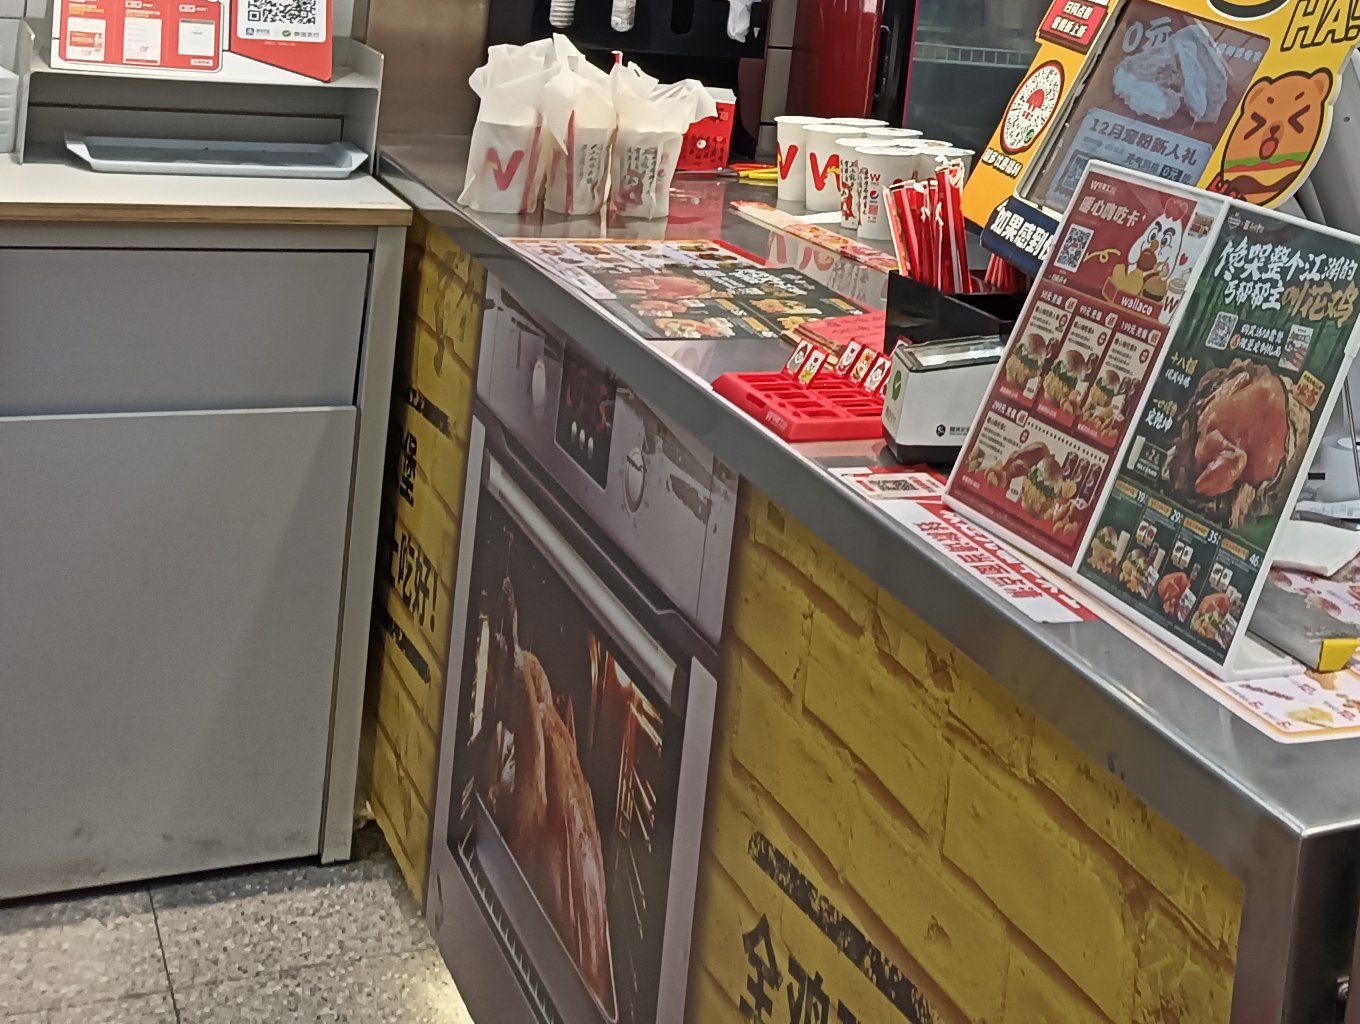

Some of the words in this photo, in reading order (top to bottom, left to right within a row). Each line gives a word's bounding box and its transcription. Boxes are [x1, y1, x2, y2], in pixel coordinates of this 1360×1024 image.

[1213, 235, 1359, 282] 馋哭整个江湖的
[1120, 295, 1154, 316] wallace
[1170, 508, 1180, 523] 29
[1207, 529, 1217, 544] 35
[1249, 552, 1260, 567] 46
